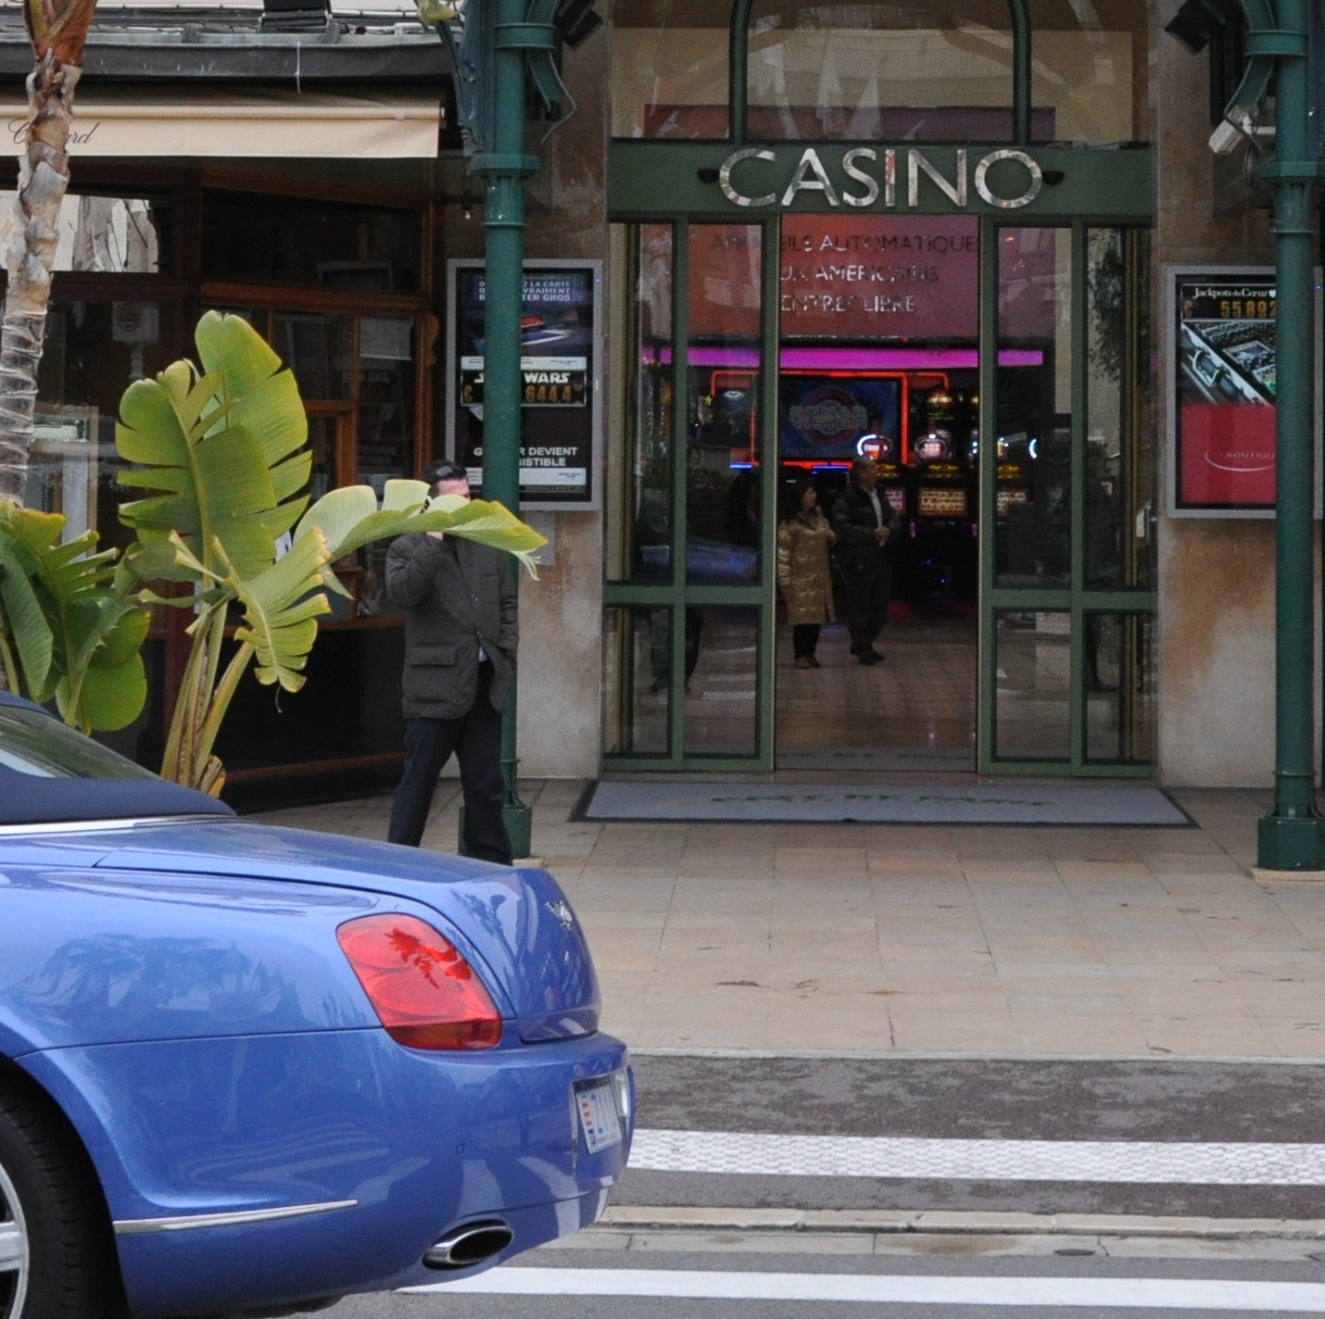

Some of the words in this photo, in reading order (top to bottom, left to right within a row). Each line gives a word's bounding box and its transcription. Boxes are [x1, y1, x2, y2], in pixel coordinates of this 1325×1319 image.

[718, 147, 1043, 209] CASINO
[1193, 287, 1231, 299] Jackpots
[523, 372, 571, 384] WARS
[528, 446, 578, 456] DEVIENT
